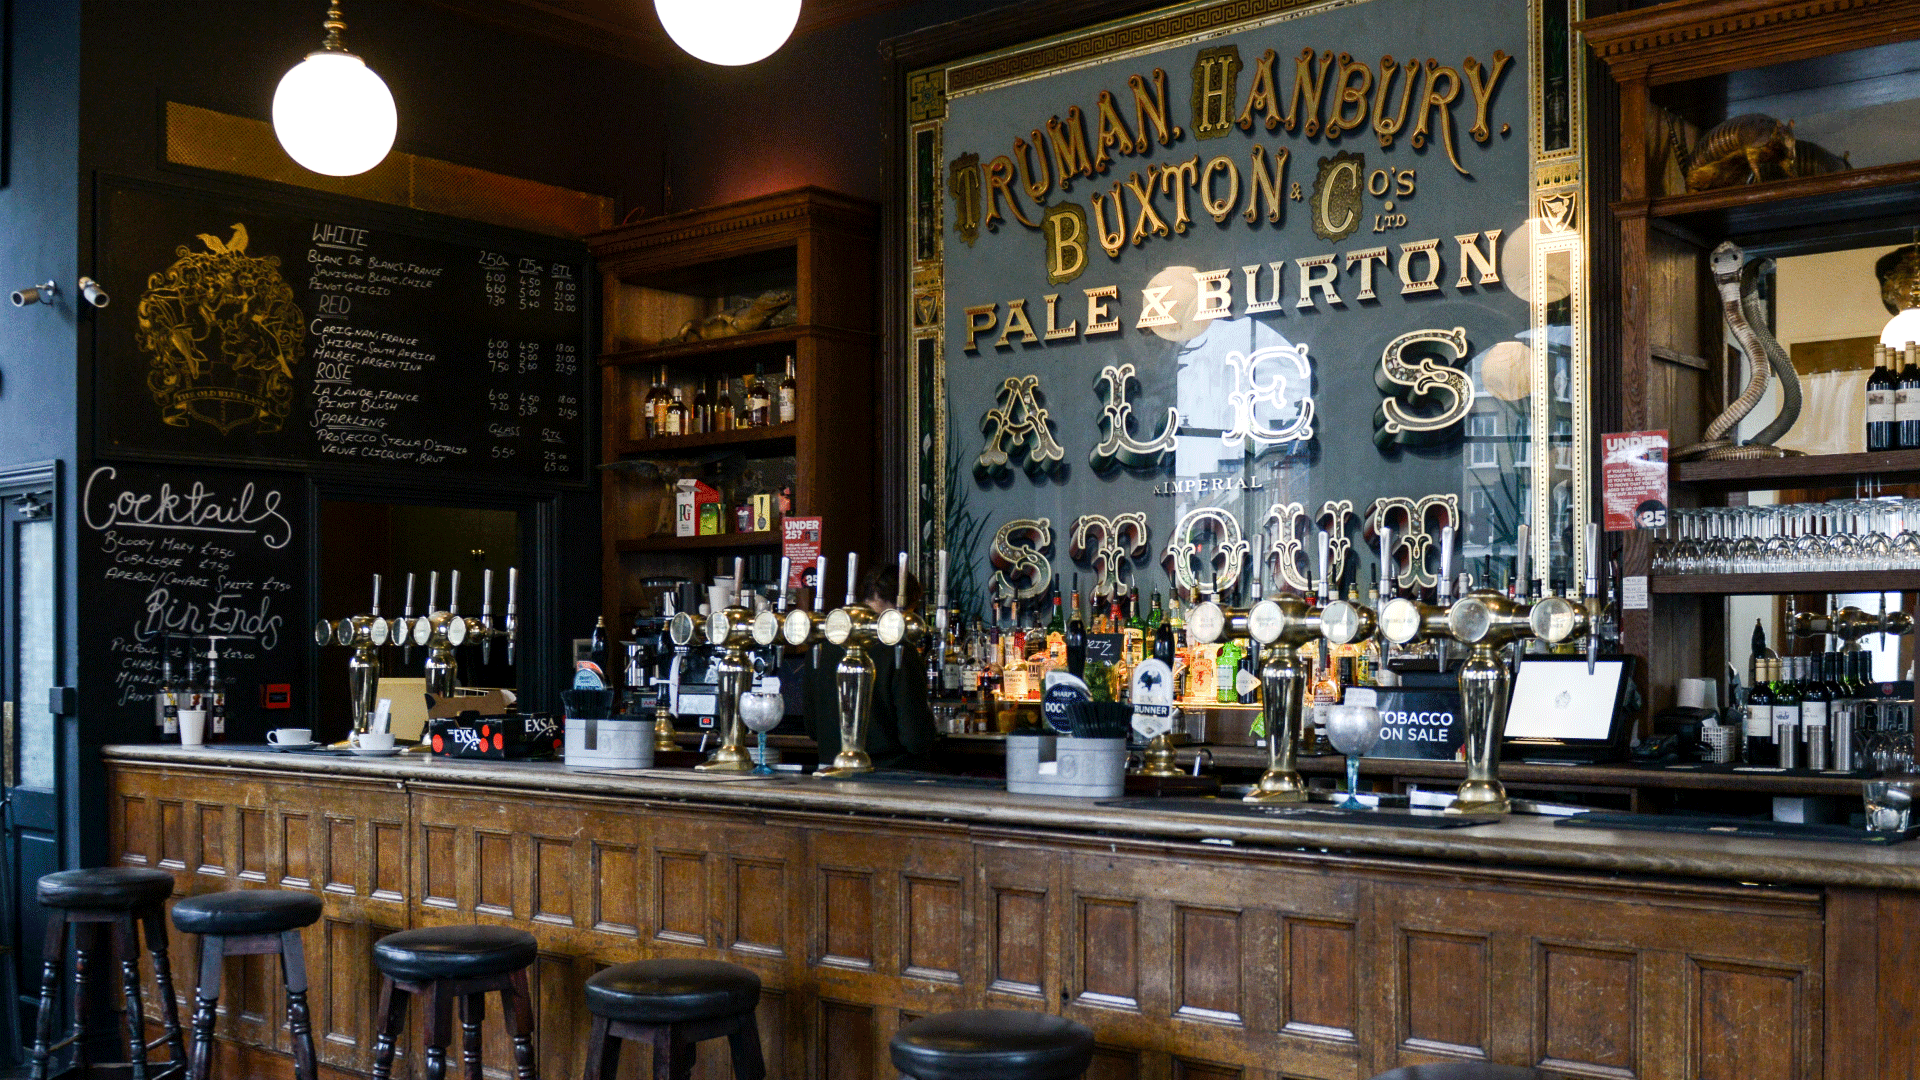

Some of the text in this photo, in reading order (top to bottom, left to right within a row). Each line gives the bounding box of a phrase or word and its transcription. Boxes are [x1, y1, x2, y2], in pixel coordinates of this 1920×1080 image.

[1050, 143, 1288, 277] BUXTON
[1289, 182, 1302, 201] &
[1373, 214, 1406, 232] LTD
[312, 222, 369, 247] WHITE
[307, 249, 342, 265] BLANC
[309, 277, 390, 295] PINOT GRIGIO
[963, 229, 1502, 350] PALE & BURTON
[319, 294, 350, 314] RED
[380, 333, 418, 345] FRANCE
[361, 356, 421, 371] ARGENTINA
[397, 350, 435, 361] AFRICA
[315, 362, 353, 379] ROSE
[312, 384, 330, 395] LA
[378, 390, 419, 402] FRANCE
[979, 326, 1475, 466] ALES
[318, 396, 397, 412] PINOT BLUSH
[309, 409, 387, 428] SPARKLING
[316, 429, 376, 444] PROSECCO
[380, 434, 421, 447] STELLA
[1607, 435, 1663, 450] UNDER
[321, 443, 357, 455] VEUVE
[419, 453, 445, 464] BRUT
[1153, 475, 1262, 494] & IMPERIAL
[84, 466, 291, 548] Cocktails
[785, 520, 819, 530] UNDER
[1643, 510, 1666, 526] 25
[101, 530, 155, 553] BLOODY
[161, 538, 195, 553] MARY
[785, 530, 802, 539] 25?
[995, 494, 1459, 599] STOUT
[1134, 705, 1167, 715] RUNNER
[1378, 711, 1453, 726] TOBACCO
[1379, 727, 1448, 742] ON SALE
